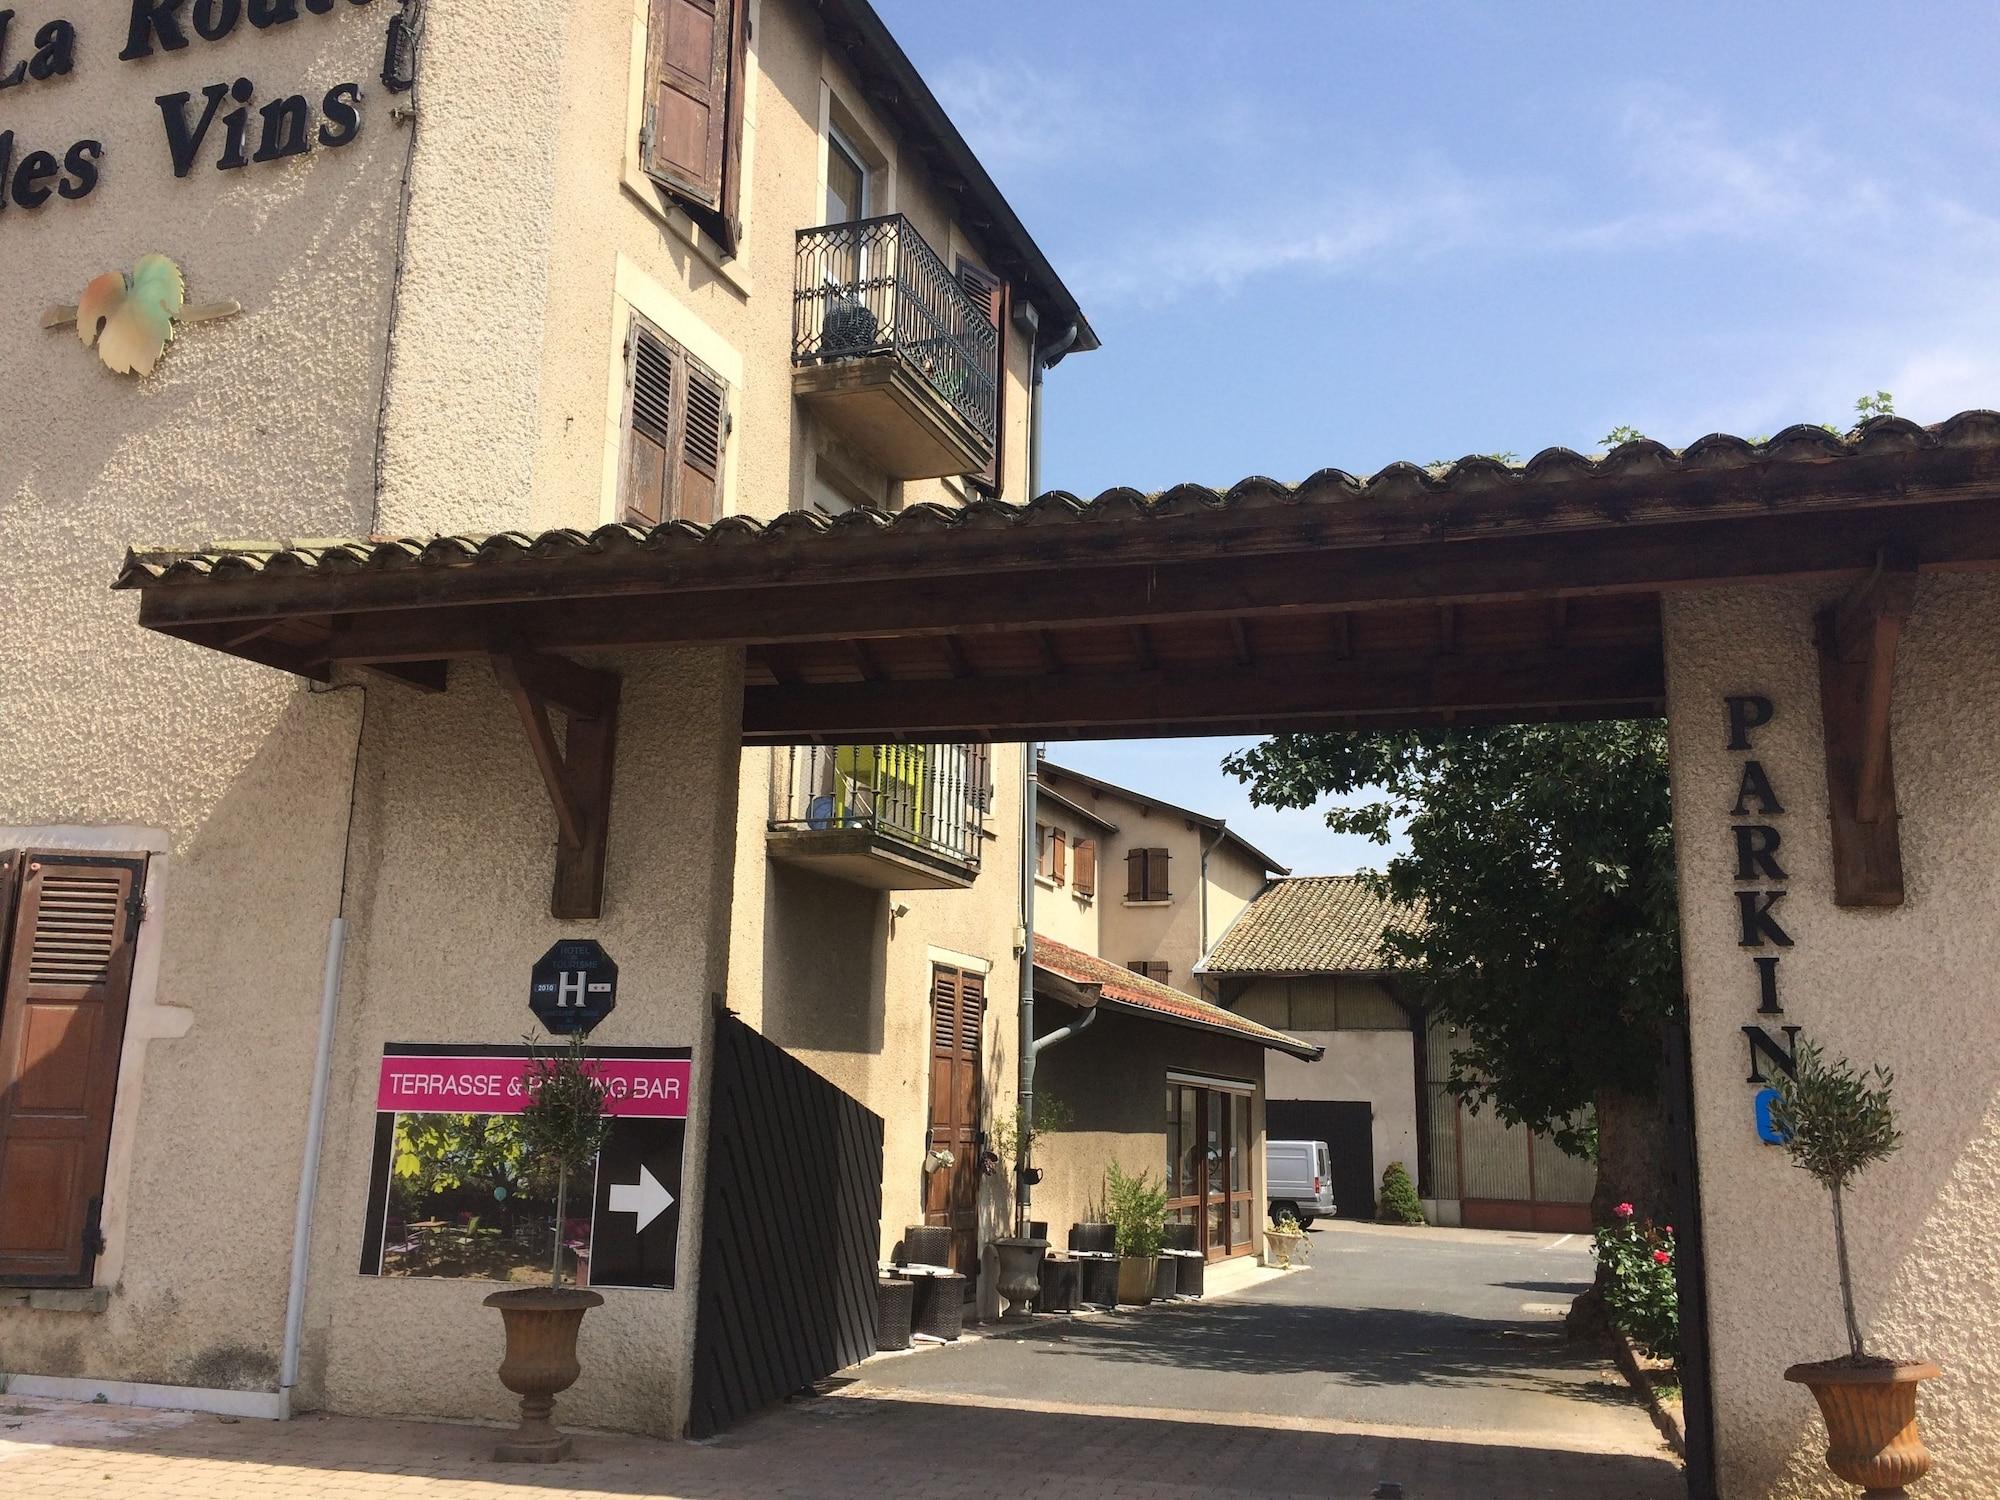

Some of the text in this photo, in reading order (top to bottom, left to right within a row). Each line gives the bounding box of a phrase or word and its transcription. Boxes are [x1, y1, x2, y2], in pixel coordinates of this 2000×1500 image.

[155, 77, 361, 178] Vins
[537, 984, 554, 992] 2010
[556, 971, 587, 1008] H
[390, 1074, 502, 1096] TERRASSE
[507, 1075, 522, 1096] &
[633, 1078, 680, 1099] BAR
